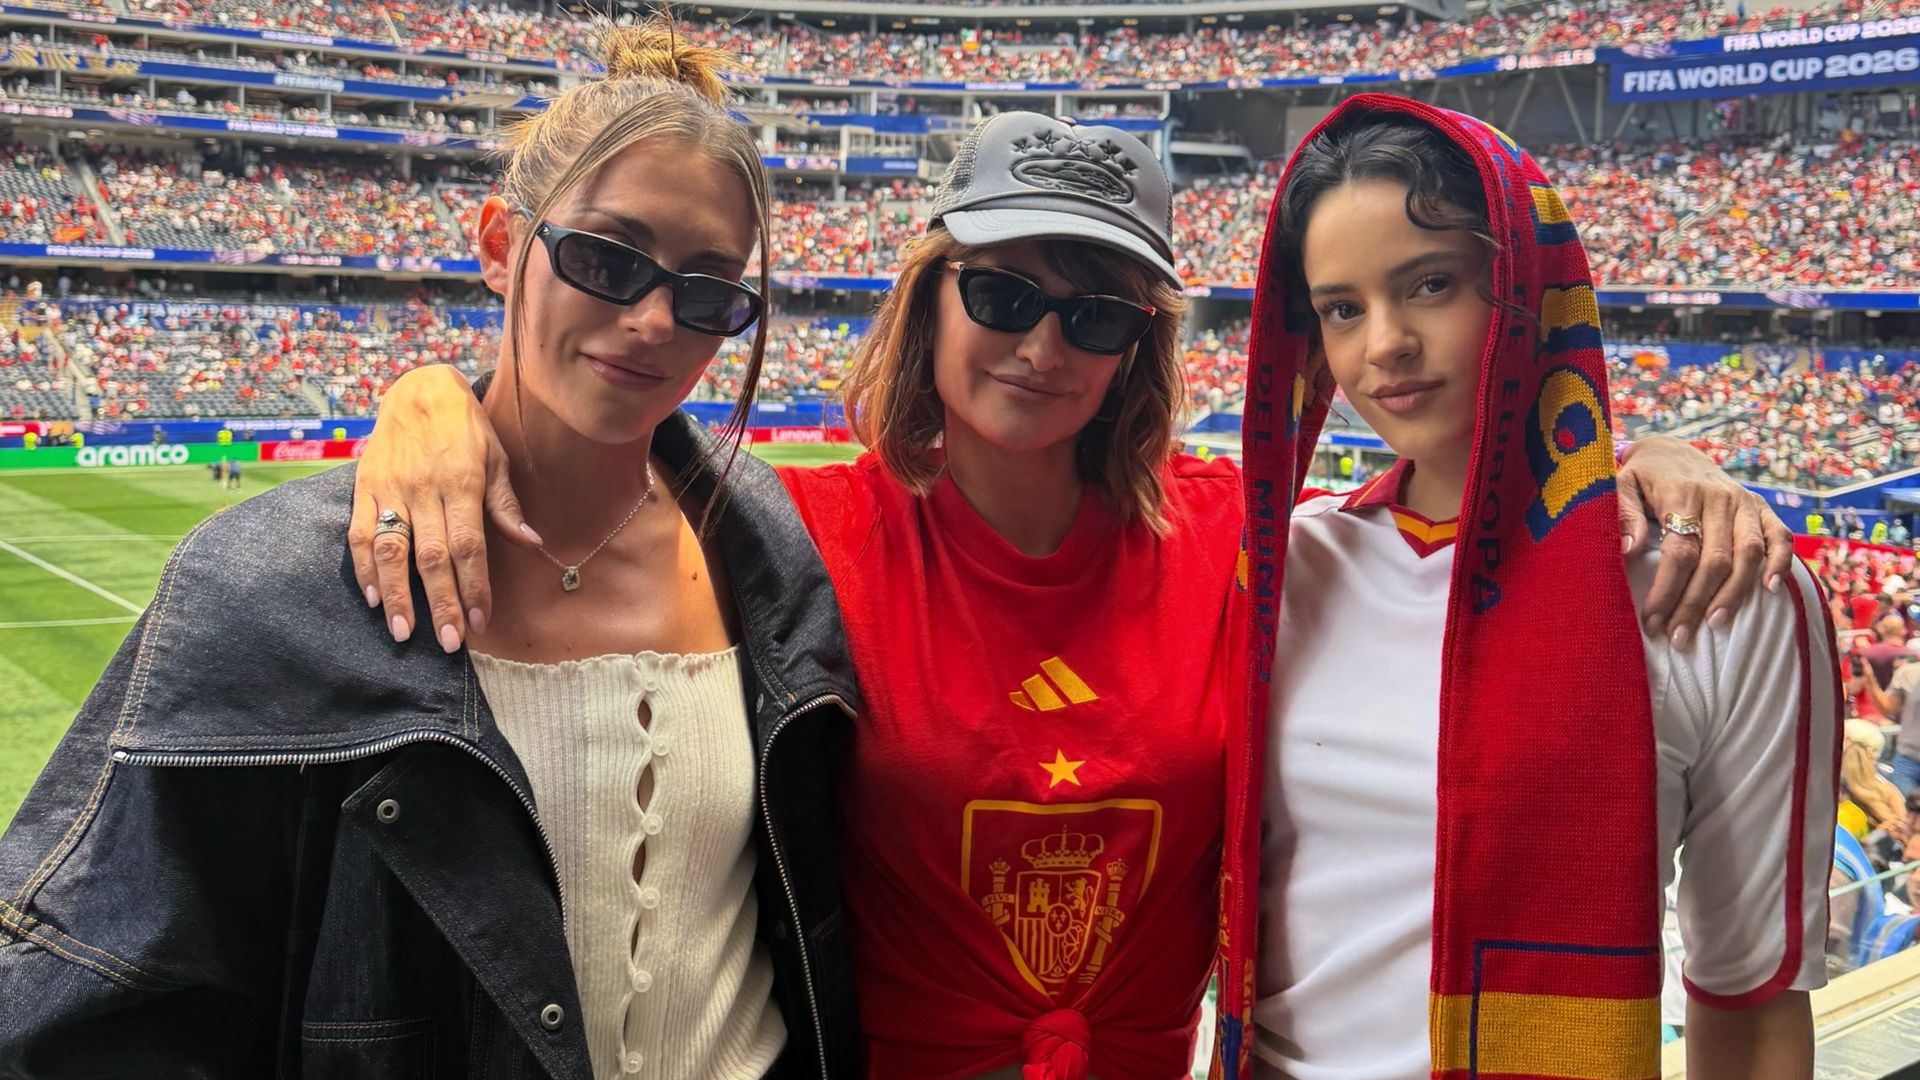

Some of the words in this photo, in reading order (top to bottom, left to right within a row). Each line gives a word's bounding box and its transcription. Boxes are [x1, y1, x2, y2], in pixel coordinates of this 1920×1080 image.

[1723, 33, 1761, 52] FIFA
[1760, 27, 1824, 49] WORLD
[1824, 23, 1862, 43] CUP
[1860, 16, 1920, 39] 2026
[1623, 69, 1678, 93] FIFA
[1677, 62, 1769, 90] WORLD
[1770, 57, 1824, 83] CUP
[1824, 47, 1920, 78] 2026
[770, 427, 824, 442] Lenovo
[77, 443, 190, 467] aramco
[1471, 378, 1522, 616] EUROPA
